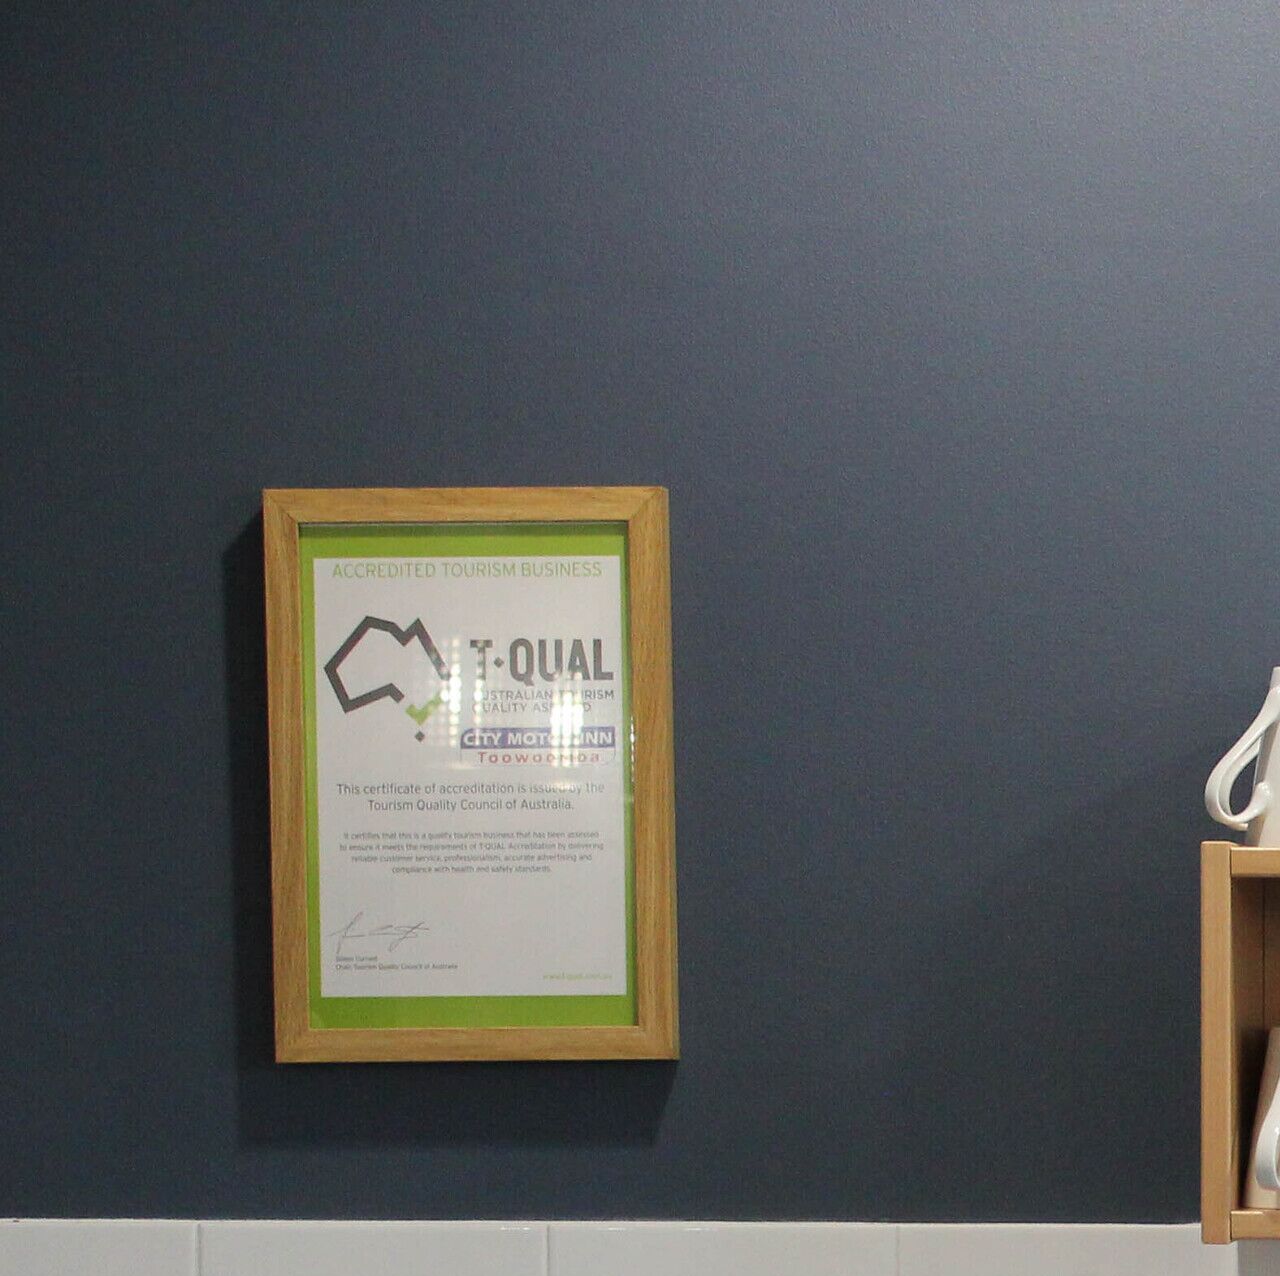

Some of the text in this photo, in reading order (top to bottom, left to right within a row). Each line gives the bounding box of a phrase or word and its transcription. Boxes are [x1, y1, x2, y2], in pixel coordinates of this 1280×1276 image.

[332, 561, 602, 578] ACCREDITED TOURISM BUSINESS
[473, 689, 615, 701] USTRALIAN TORISM
[337, 784, 360, 795] This
[363, 783, 421, 795] certificate
[425, 784, 436, 794] of
[440, 783, 514, 794] accreditation
[518, 783, 527, 793] is
[369, 800, 413, 811] Tourism
[417, 800, 456, 812] Quality
[460, 799, 502, 811] Council
[505, 799, 517, 810] of
